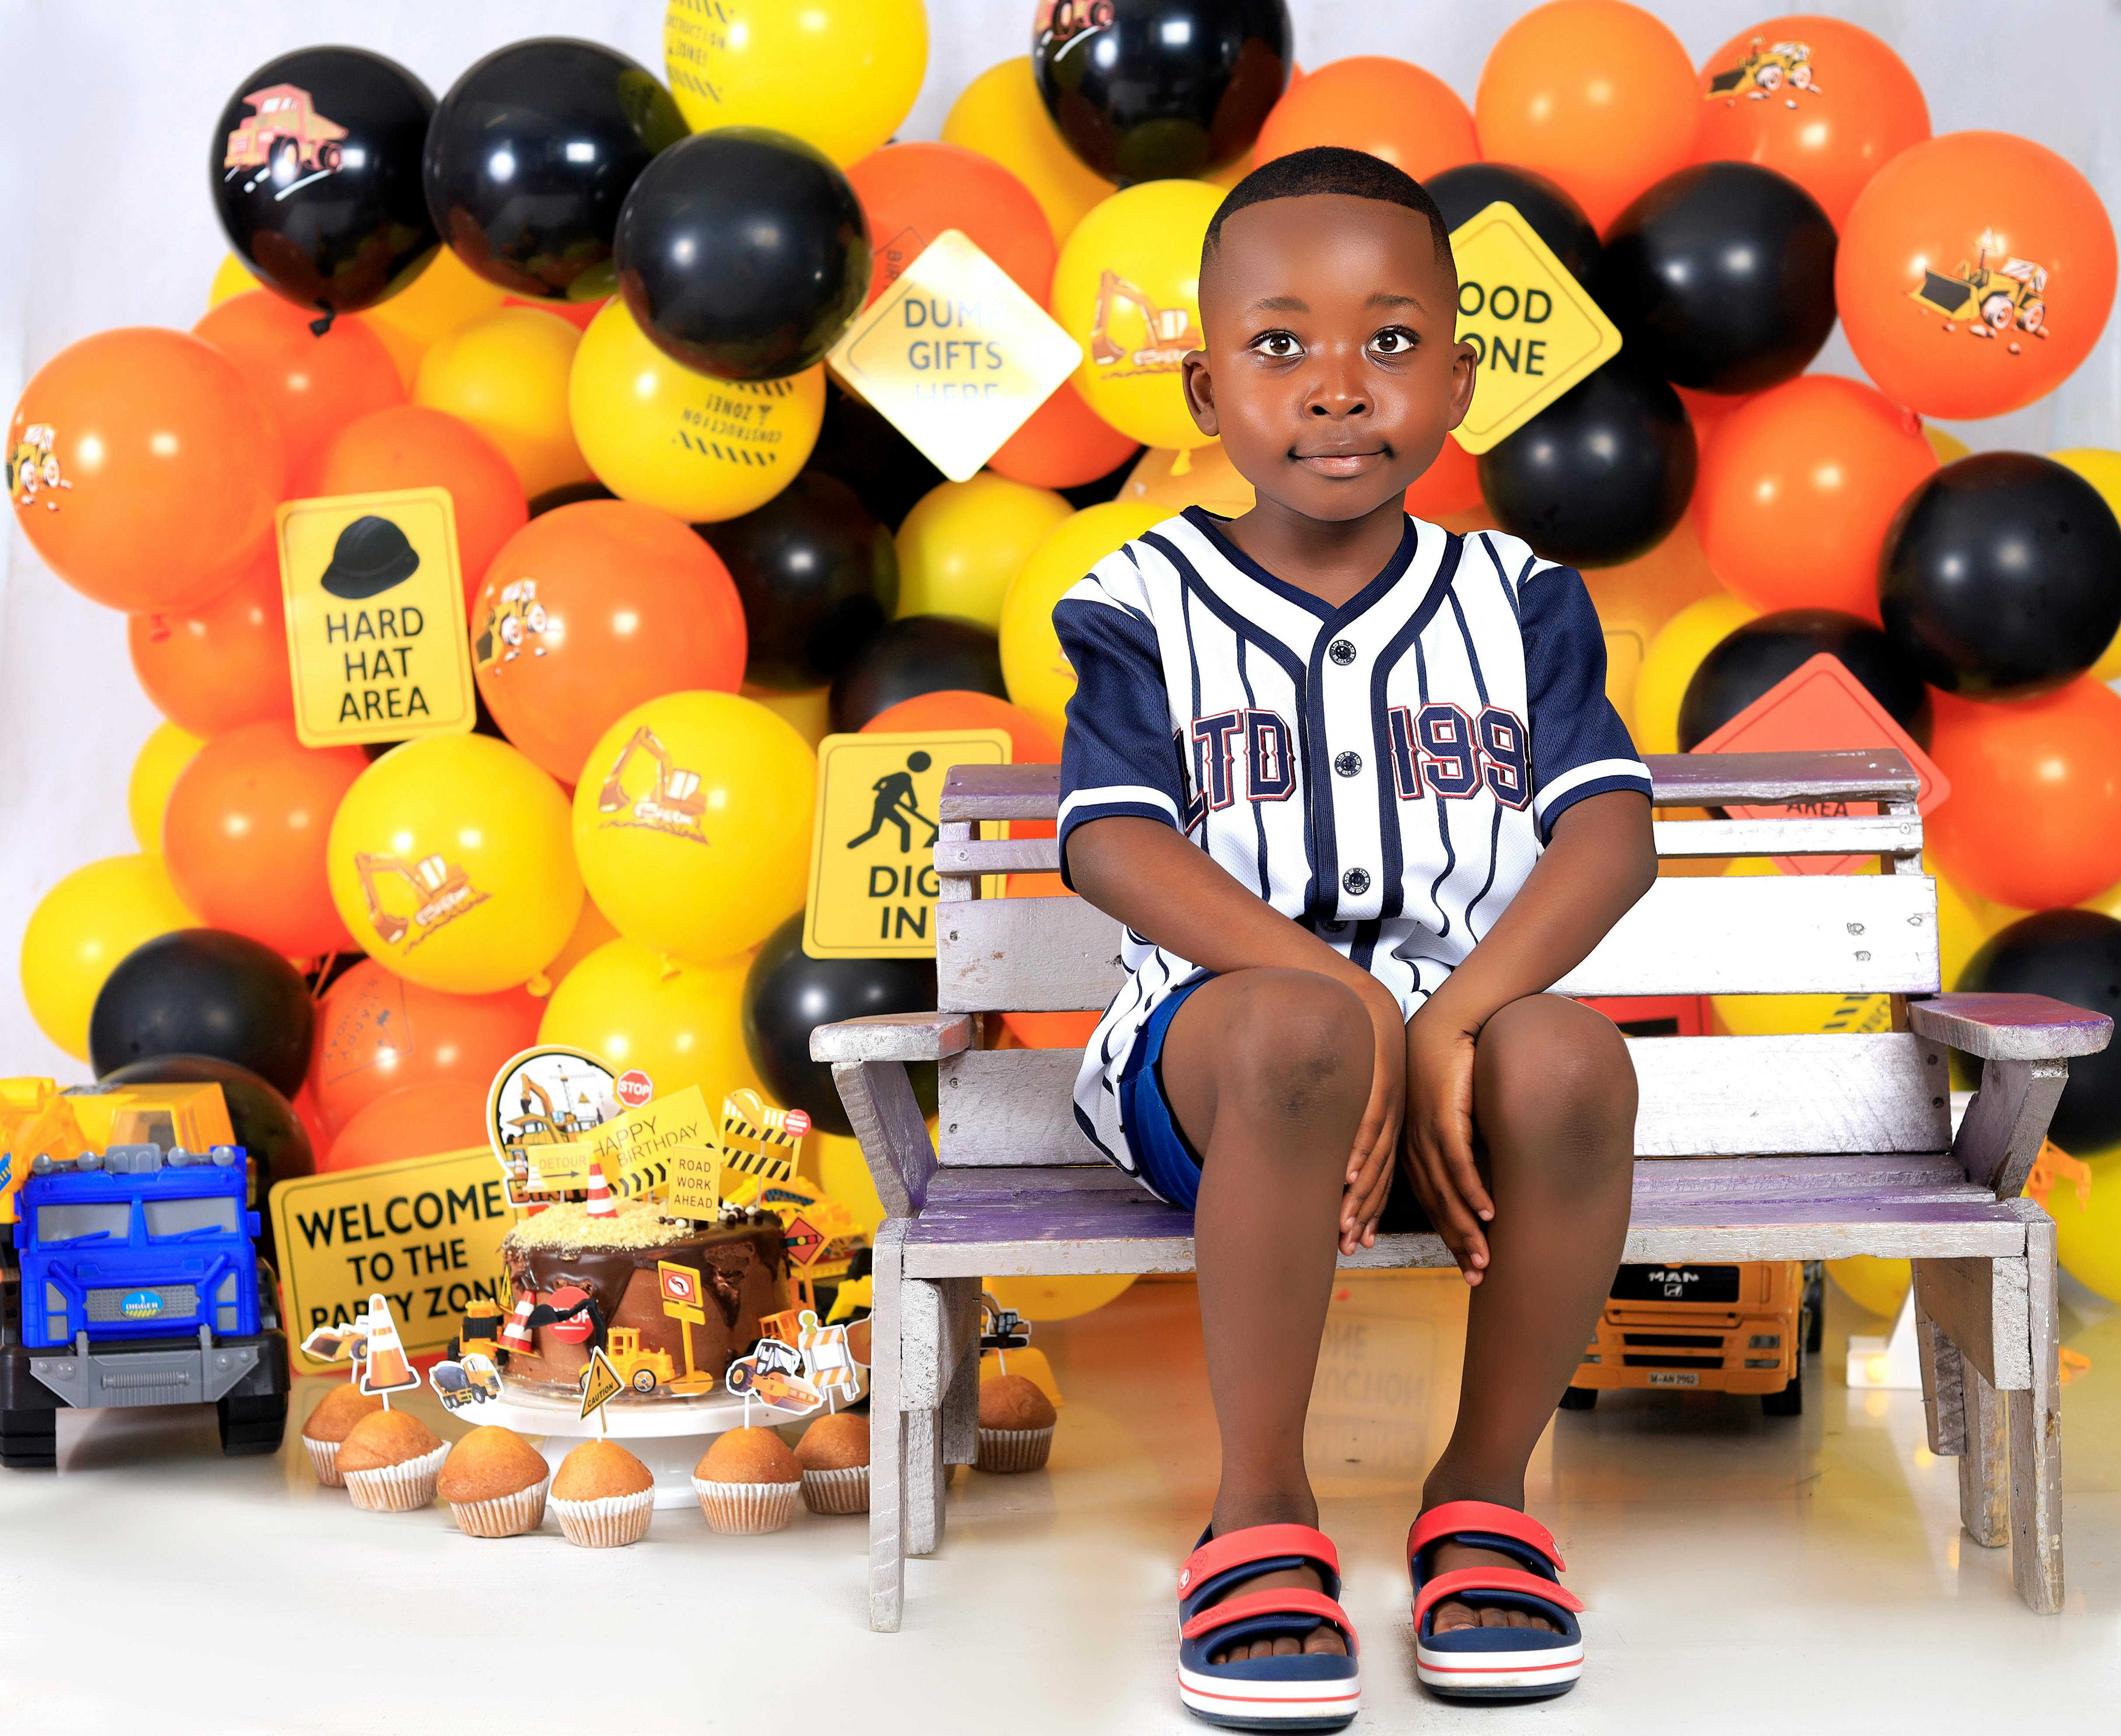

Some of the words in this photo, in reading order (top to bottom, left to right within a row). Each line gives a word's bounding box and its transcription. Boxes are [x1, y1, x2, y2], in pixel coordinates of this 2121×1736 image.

[905, 298, 1004, 328] DUMP
[1458, 281, 1553, 324] OOD
[908, 340, 1003, 370] GIFTS
[1459, 332, 1547, 376] ONE
[326, 606, 424, 644] HARD
[345, 647, 413, 682] HAT
[339, 685, 430, 723] AREA
[1172, 707, 1296, 836] LTD
[868, 864, 940, 897] DIG
[881, 906, 927, 939] IN
[619, 1080, 650, 1096] STOP
[593, 1115, 656, 1158] HAPPY
[616, 1121, 698, 1168] BIRTHDAY
[539, 1155, 587, 1170] DETOUR
[679, 1159, 711, 1172] ROAD
[677, 1176, 711, 1190] WORK
[296, 1180, 505, 1250] WELCOME
[674, 1194, 713, 1208] AHEAD
[347, 1252, 394, 1286] TO
[402, 1239, 468, 1276] THE
[1648, 1270, 1699, 1282] MAN
[126, 1302, 158, 1310] DIGGER
[311, 1291, 413, 1330] PARY
[587, 1382, 613, 1408] CAUTION
